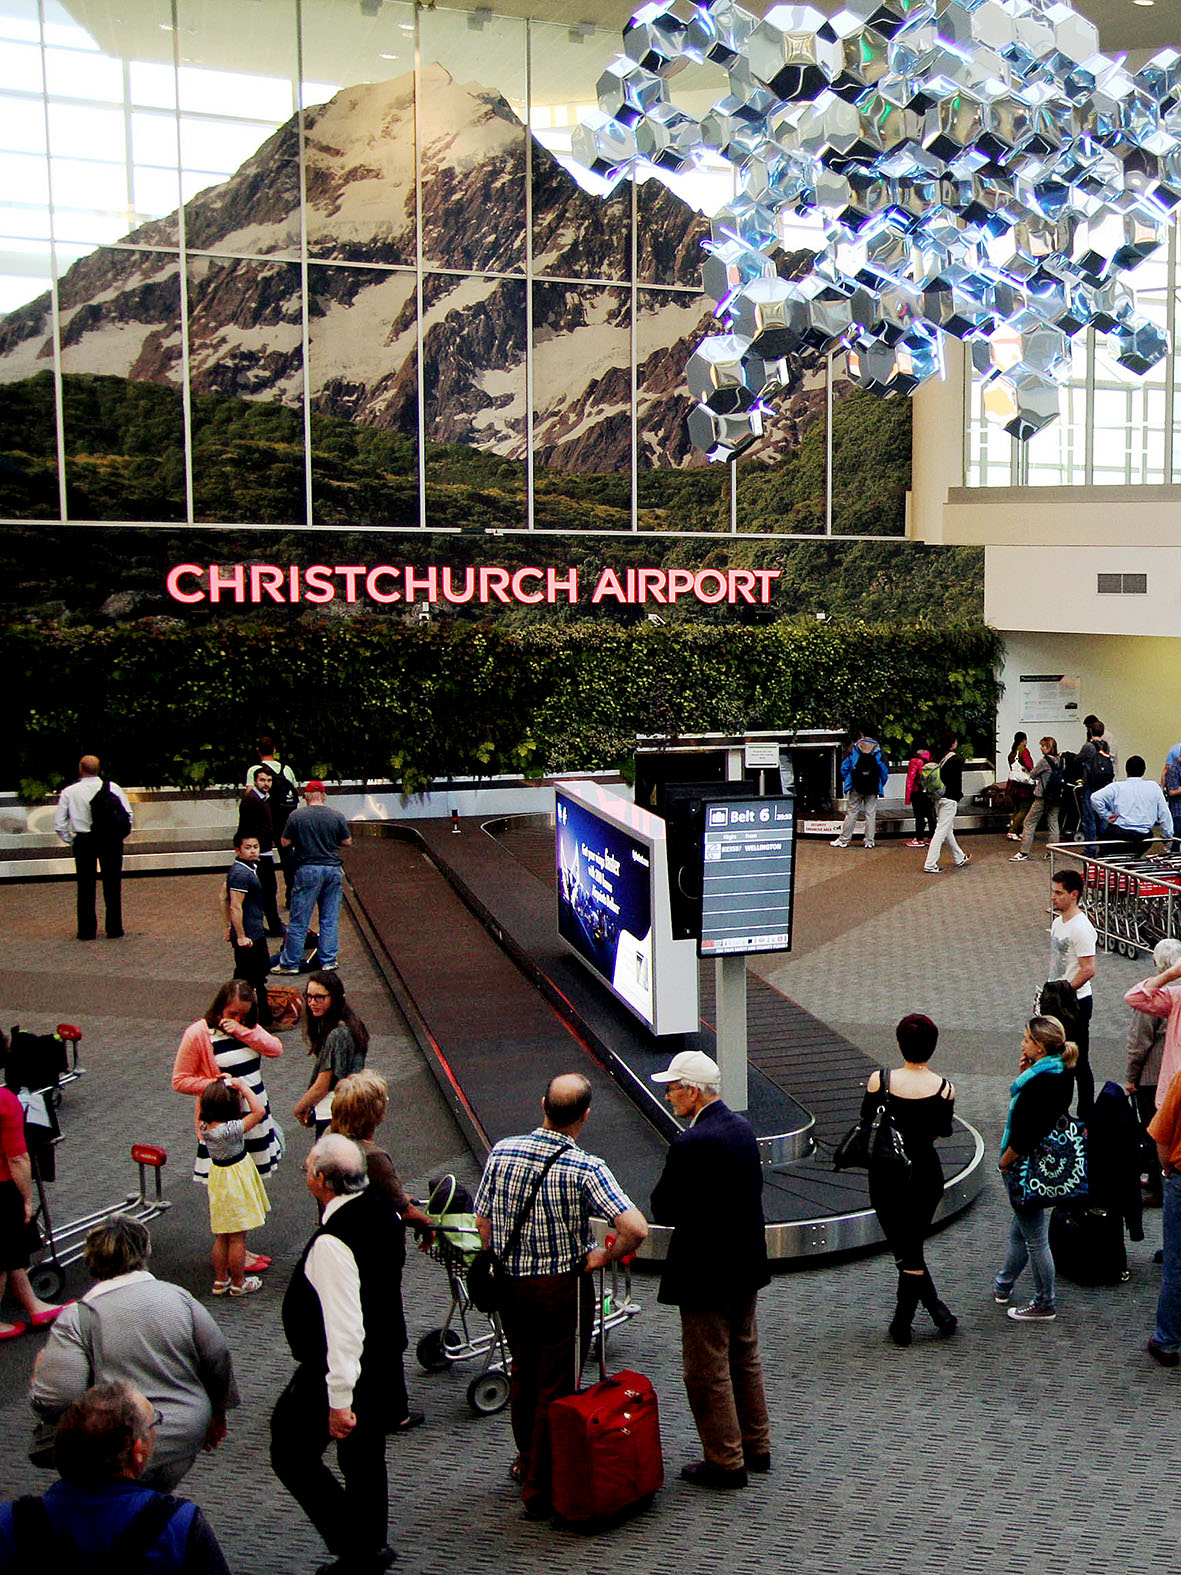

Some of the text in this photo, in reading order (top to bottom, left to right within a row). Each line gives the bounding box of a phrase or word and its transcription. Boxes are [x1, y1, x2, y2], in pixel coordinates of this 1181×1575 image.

[166, 563, 782, 604] CHRISTCHURCH AIRPORT
[730, 809, 755, 823] Belt
[759, 807, 770, 822] 6
[744, 843, 782, 852] WELLINGTON
